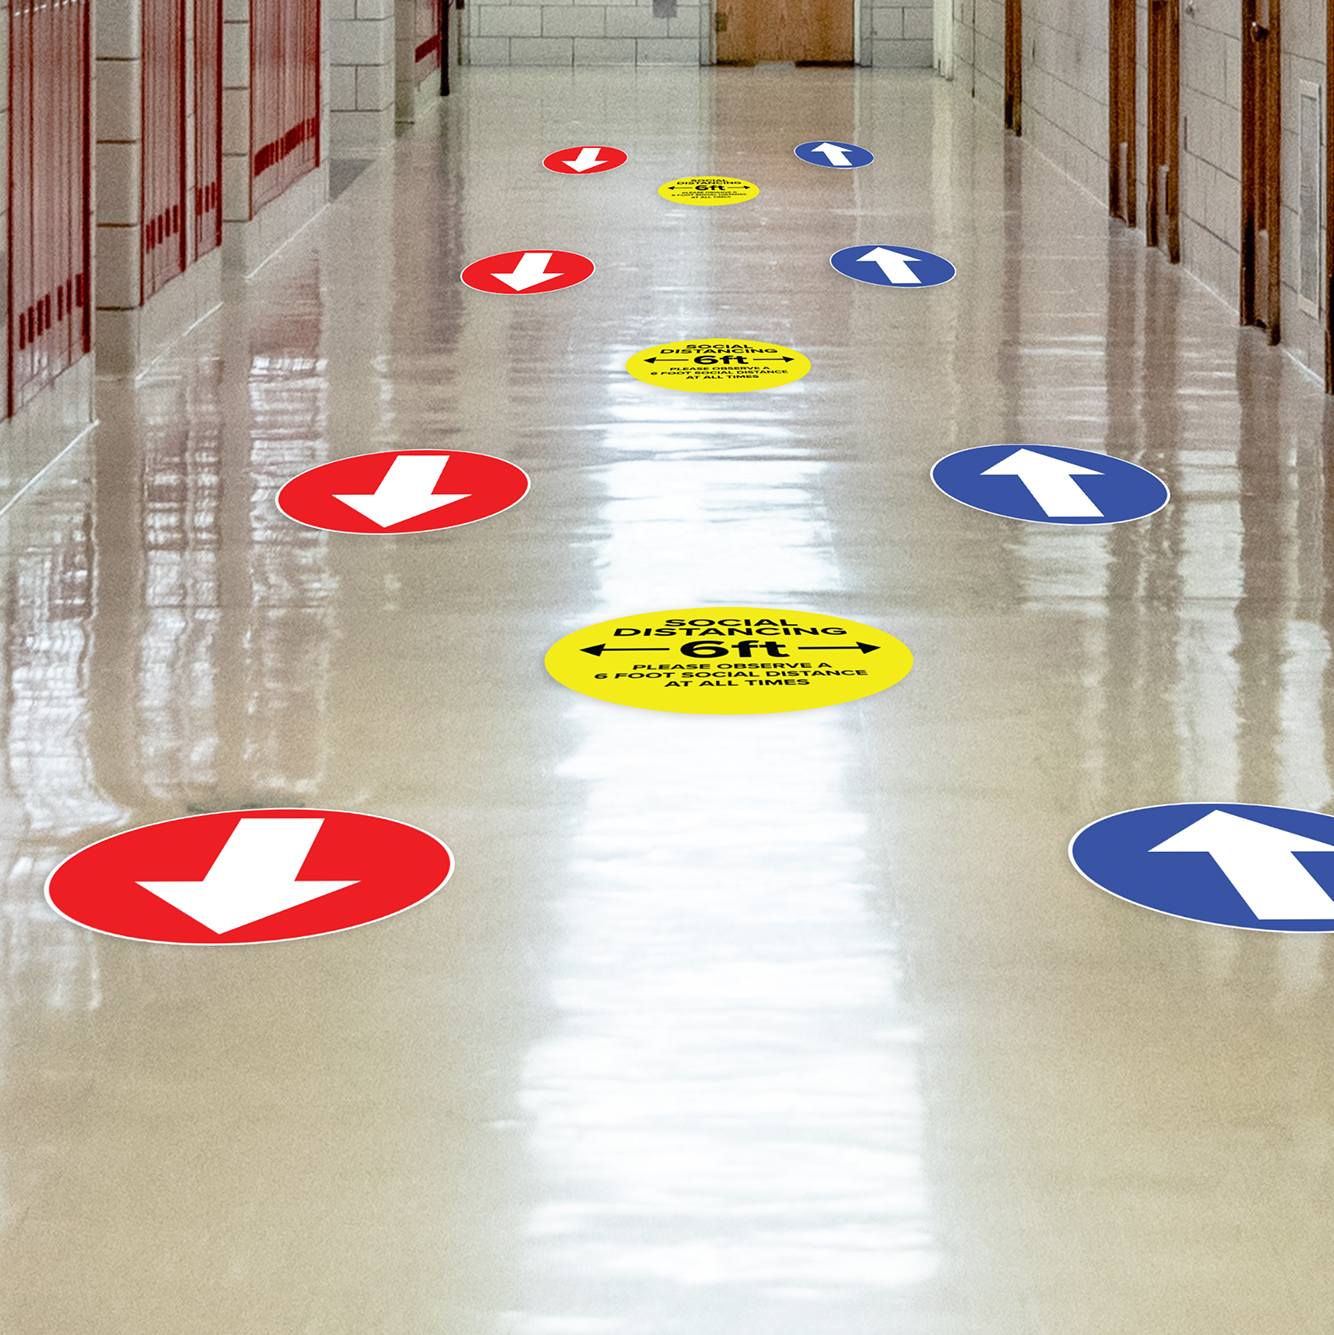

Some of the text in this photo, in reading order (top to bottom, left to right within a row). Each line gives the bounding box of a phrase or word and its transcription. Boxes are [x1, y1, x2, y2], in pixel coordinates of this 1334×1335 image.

[694, 355, 749, 365] 6ft
[664, 618, 799, 627] SOCIAL
[613, 627, 848, 636] DISTANCING
[680, 640, 790, 658] 6ft
[614, 671, 676, 679] FOOT
[765, 669, 869, 677] DISTANCE
